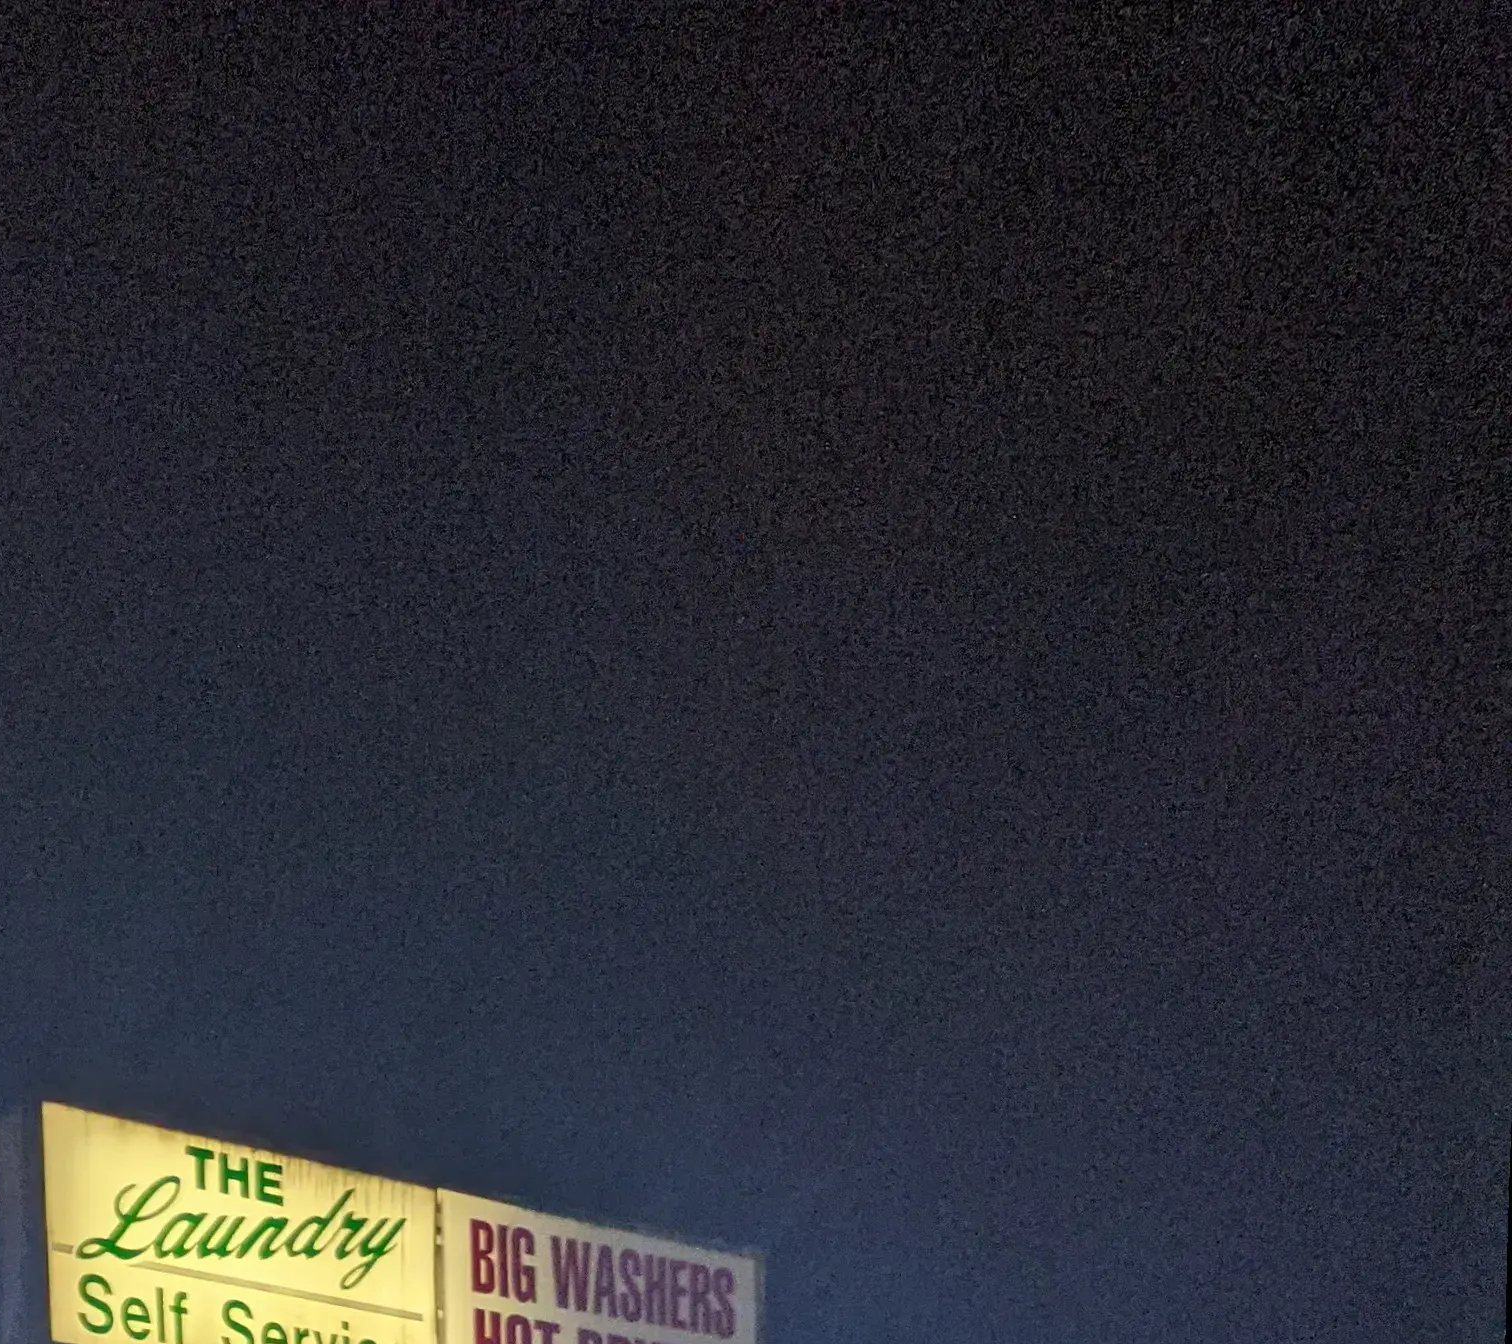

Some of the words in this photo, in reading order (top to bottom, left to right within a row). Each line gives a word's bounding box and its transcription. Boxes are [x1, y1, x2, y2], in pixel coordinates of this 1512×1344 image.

[75, 1175, 407, 1290] Laundry
[185, 1145, 284, 1207] THE
[469, 1218, 537, 1304] BIG
[550, 1234, 735, 1340] WASHERS
